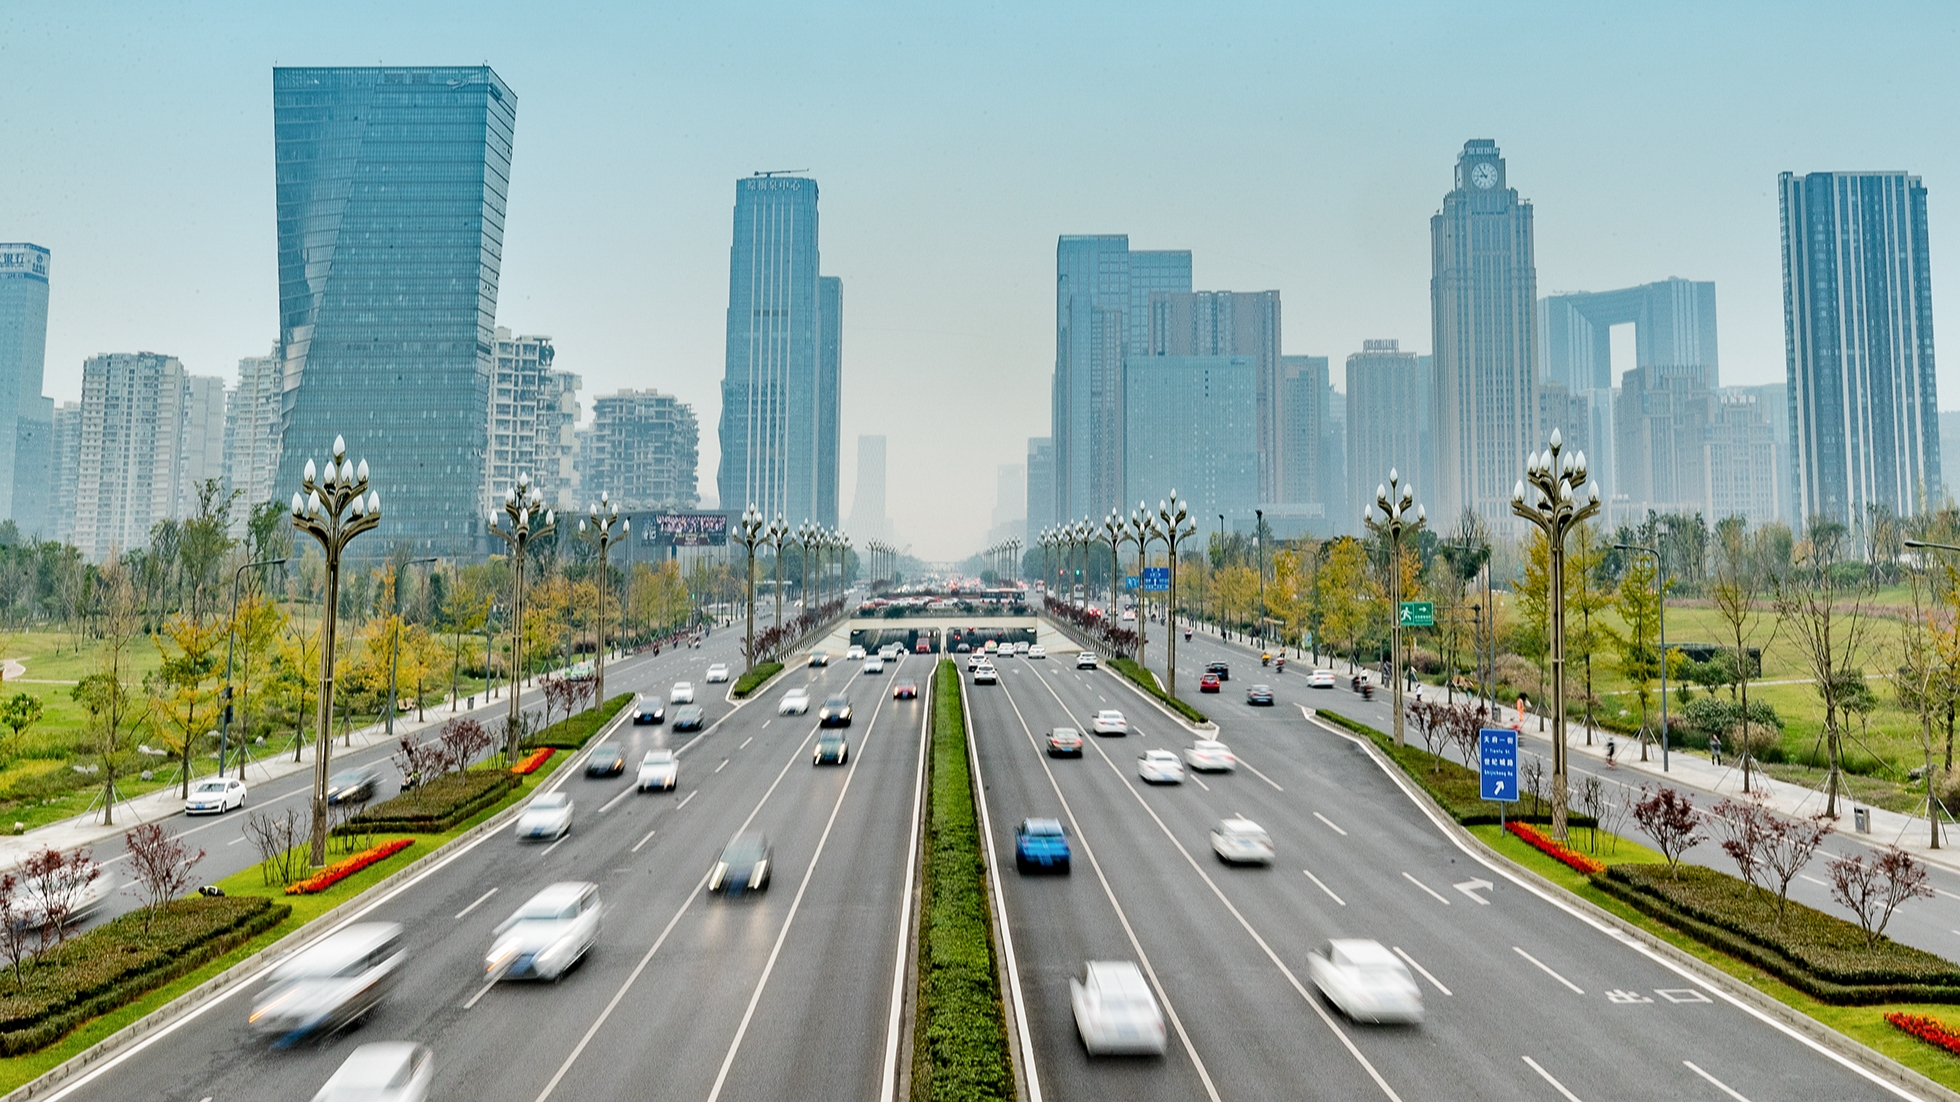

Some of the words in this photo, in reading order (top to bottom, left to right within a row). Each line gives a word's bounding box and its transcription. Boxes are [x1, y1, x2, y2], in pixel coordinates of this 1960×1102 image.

[1484, 736, 1513, 744] 天府一街
[1484, 758, 1513, 767] 世纪城路
[1604, 989, 1714, 1003] 出口
